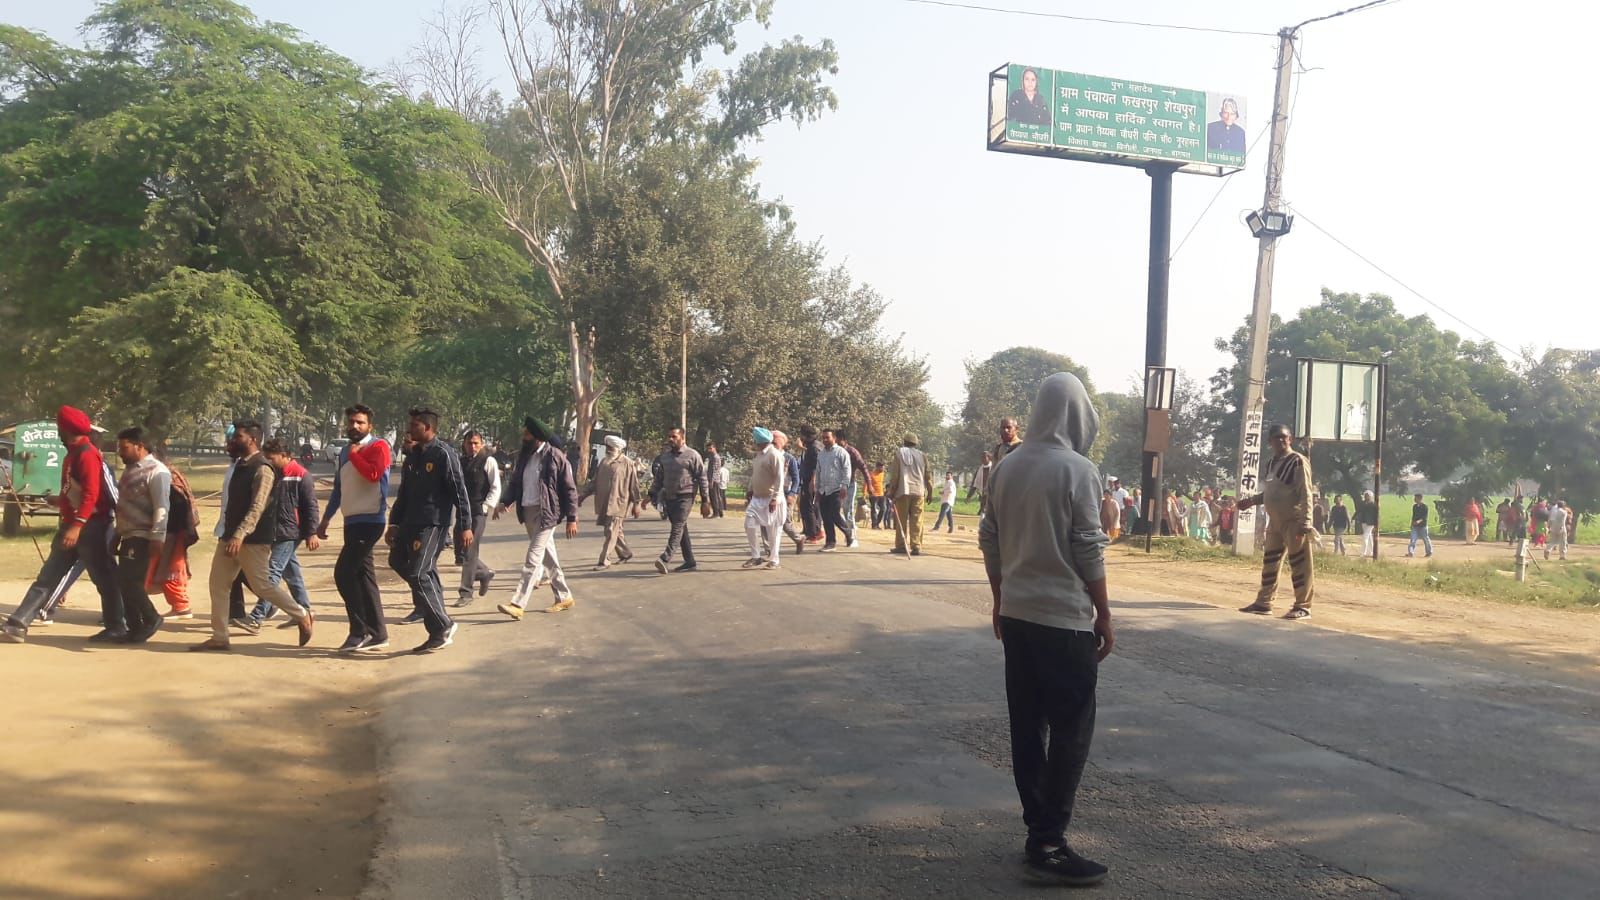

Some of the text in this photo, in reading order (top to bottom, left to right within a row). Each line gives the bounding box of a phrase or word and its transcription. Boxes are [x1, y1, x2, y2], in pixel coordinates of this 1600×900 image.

[1060, 87, 1196, 119] ग्राम पंचायत फखरपुर शेखपुरा
[1061, 103, 1069, 116] में
[1075, 108, 1109, 120] आपका
[1115, 112, 1146, 126] हार्दिक
[1152, 118, 1183, 131] स्वागत
[1076, 124, 1093, 135] प्रधान
[46, 451, 58, 467] 2
